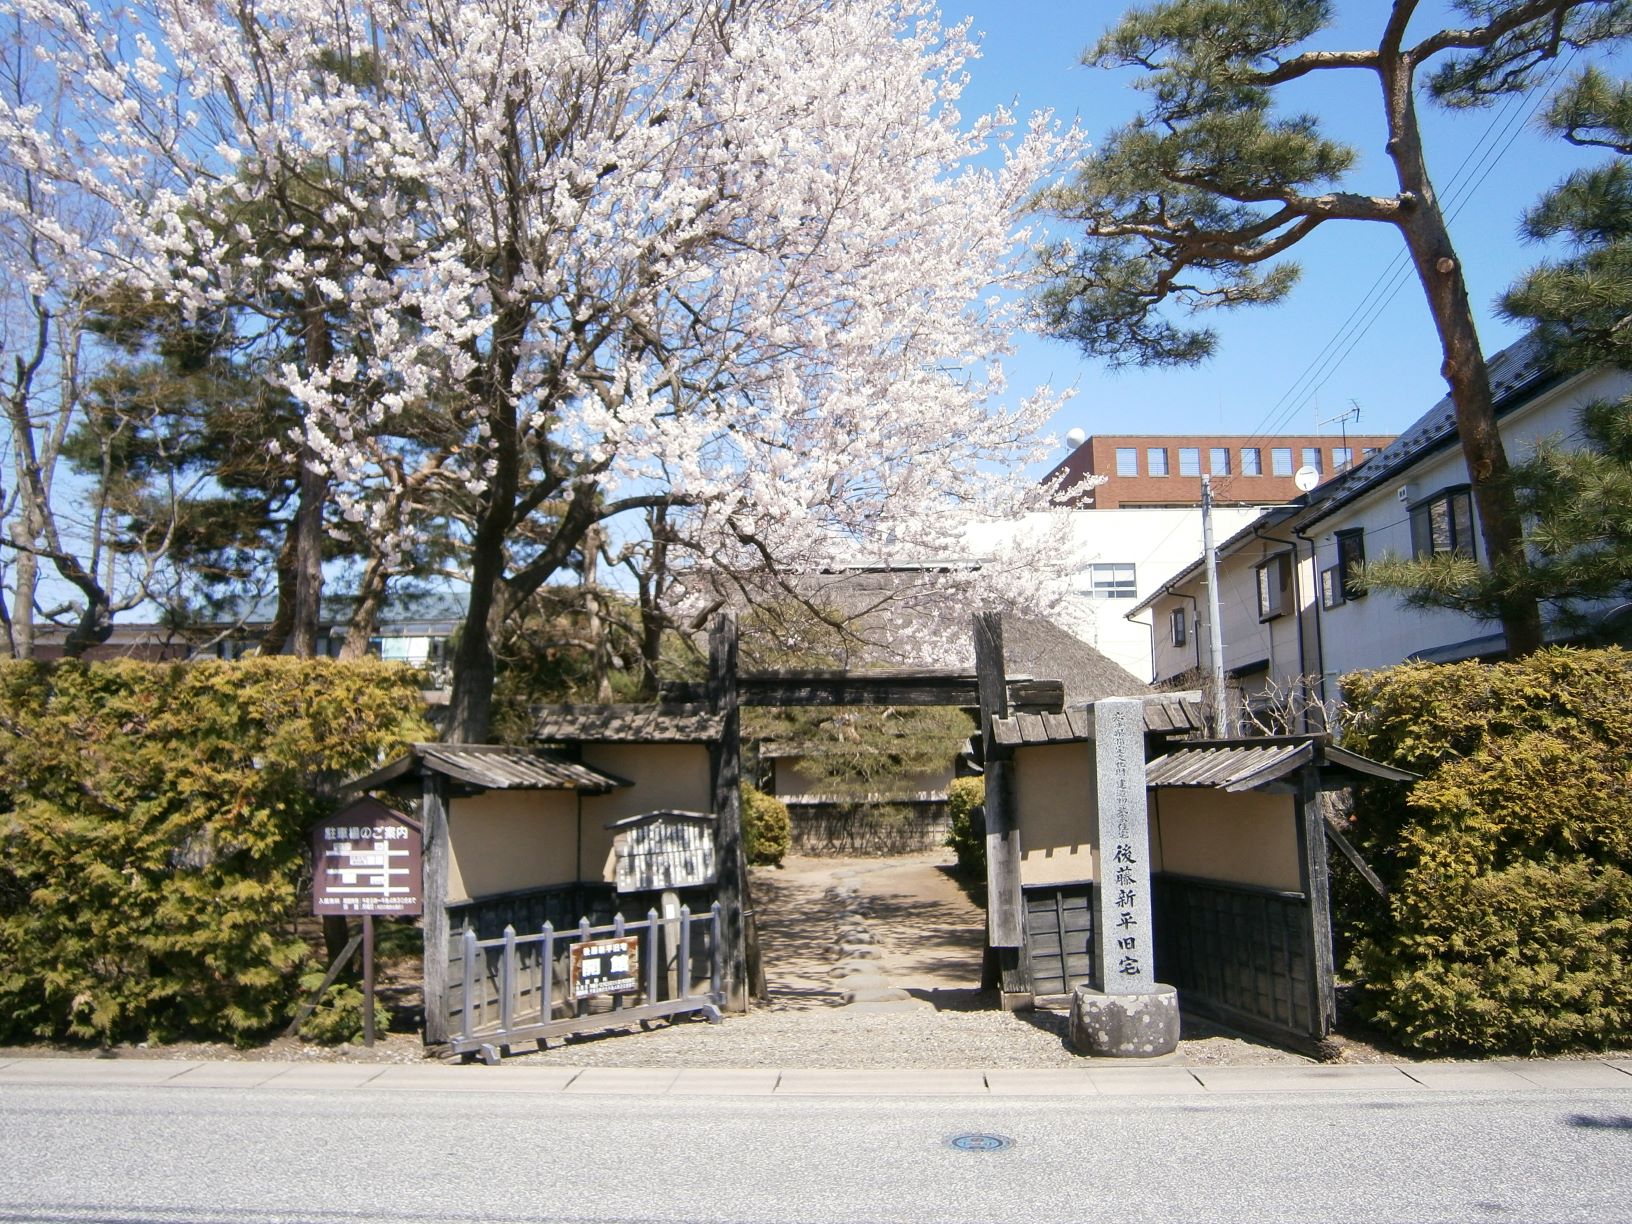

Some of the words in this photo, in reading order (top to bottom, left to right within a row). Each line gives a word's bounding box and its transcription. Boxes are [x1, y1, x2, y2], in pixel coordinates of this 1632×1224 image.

[1112, 843, 1141, 975] 後藤新平旧宅
